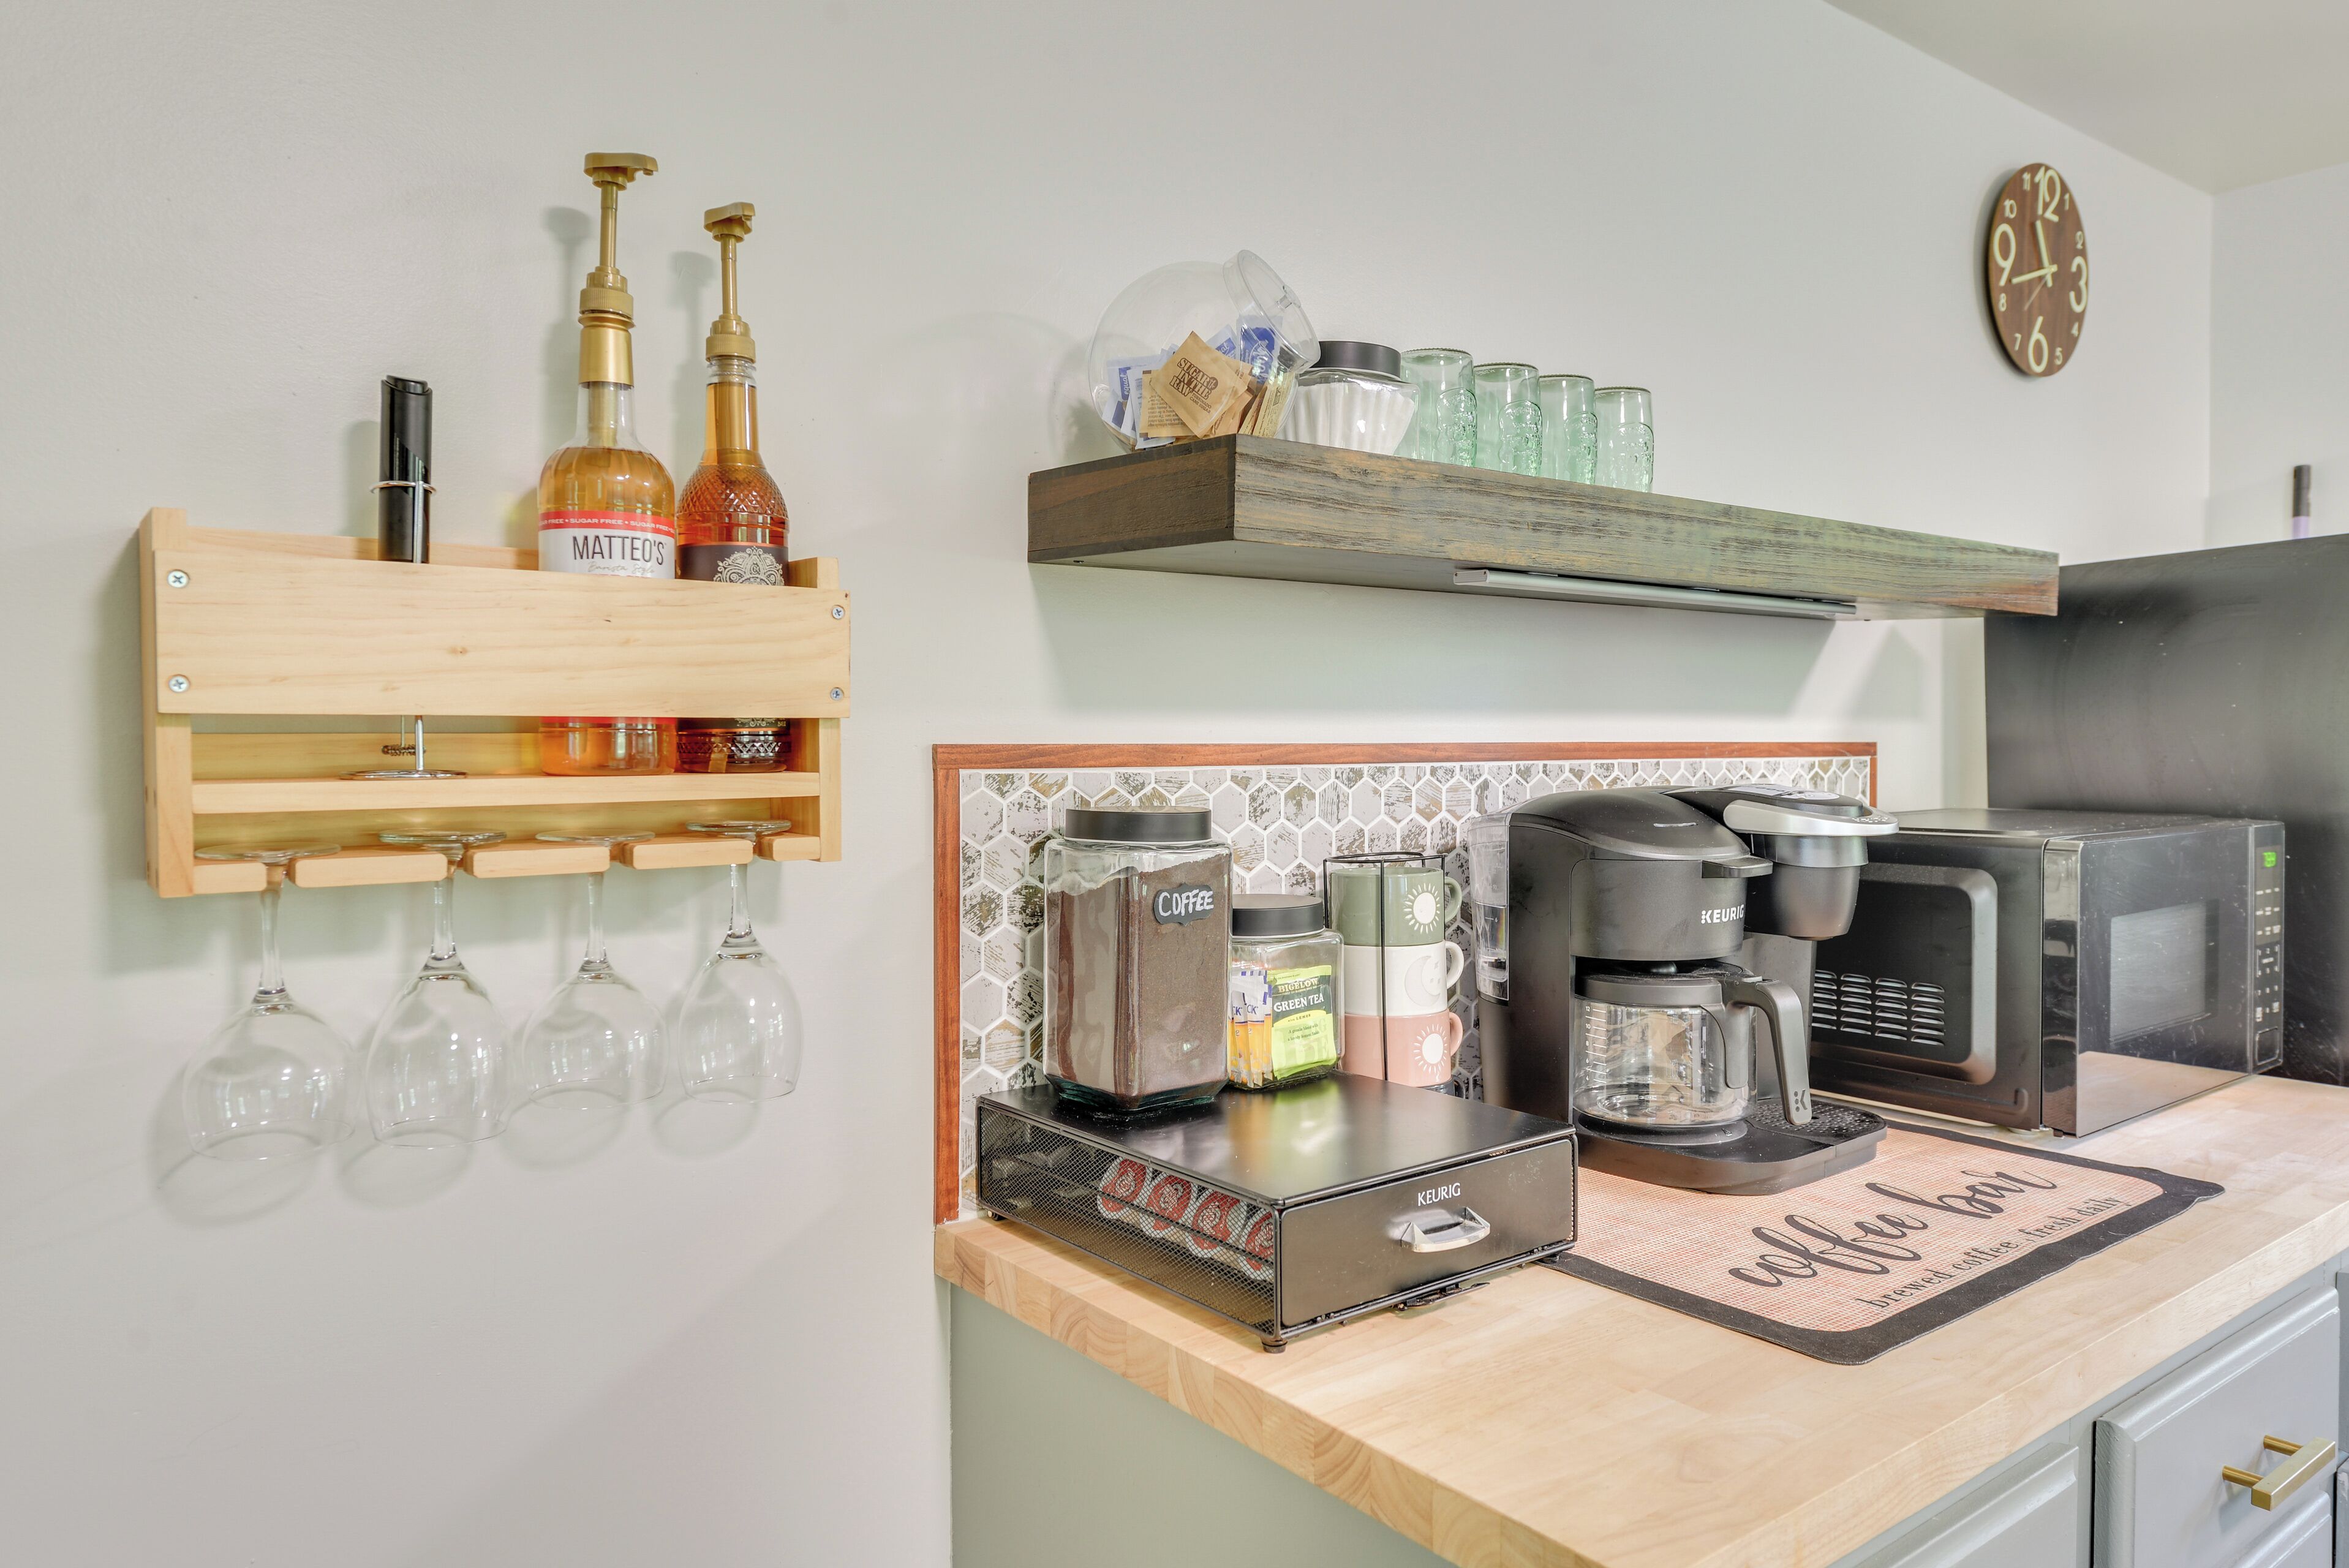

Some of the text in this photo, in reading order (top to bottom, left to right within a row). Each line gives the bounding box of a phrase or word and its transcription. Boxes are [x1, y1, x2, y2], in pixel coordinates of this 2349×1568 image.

[2022, 172, 2031, 190] 11
[2034, 165, 2061, 222] 12
[2064, 192, 2070, 210] 1
[2004, 199, 2017, 219] 10
[2076, 231, 2084, 250] 2
[1993, 223, 2016, 287] 9
[2069, 255, 2088, 313] 3
[1999, 293, 2007, 312] 8
[2071, 322, 2078, 337] 4
[2014, 333, 2021, 350] 7
[2027, 315, 2048, 374] 6
[2054, 348, 2062, 364] 5
[1177, 358, 1211, 388] SUGAR
[1169, 375, 1191, 397] RAW
[1189, 379, 1212, 400] THE
[572, 535, 665, 565] MATTEO'S
[1158, 889, 1214, 916] COFFEE
[1701, 904, 1744, 924] KEURIG
[1278, 978, 1318, 993] BIGELOW
[1273, 993, 1324, 1012] GREEN TEA
[1418, 1182, 1461, 1207] KEURIG
[1729, 1170, 2057, 1287] coffee bar
[1855, 1269, 1956, 1308] brewed
[2068, 1197, 2132, 1216] daily
